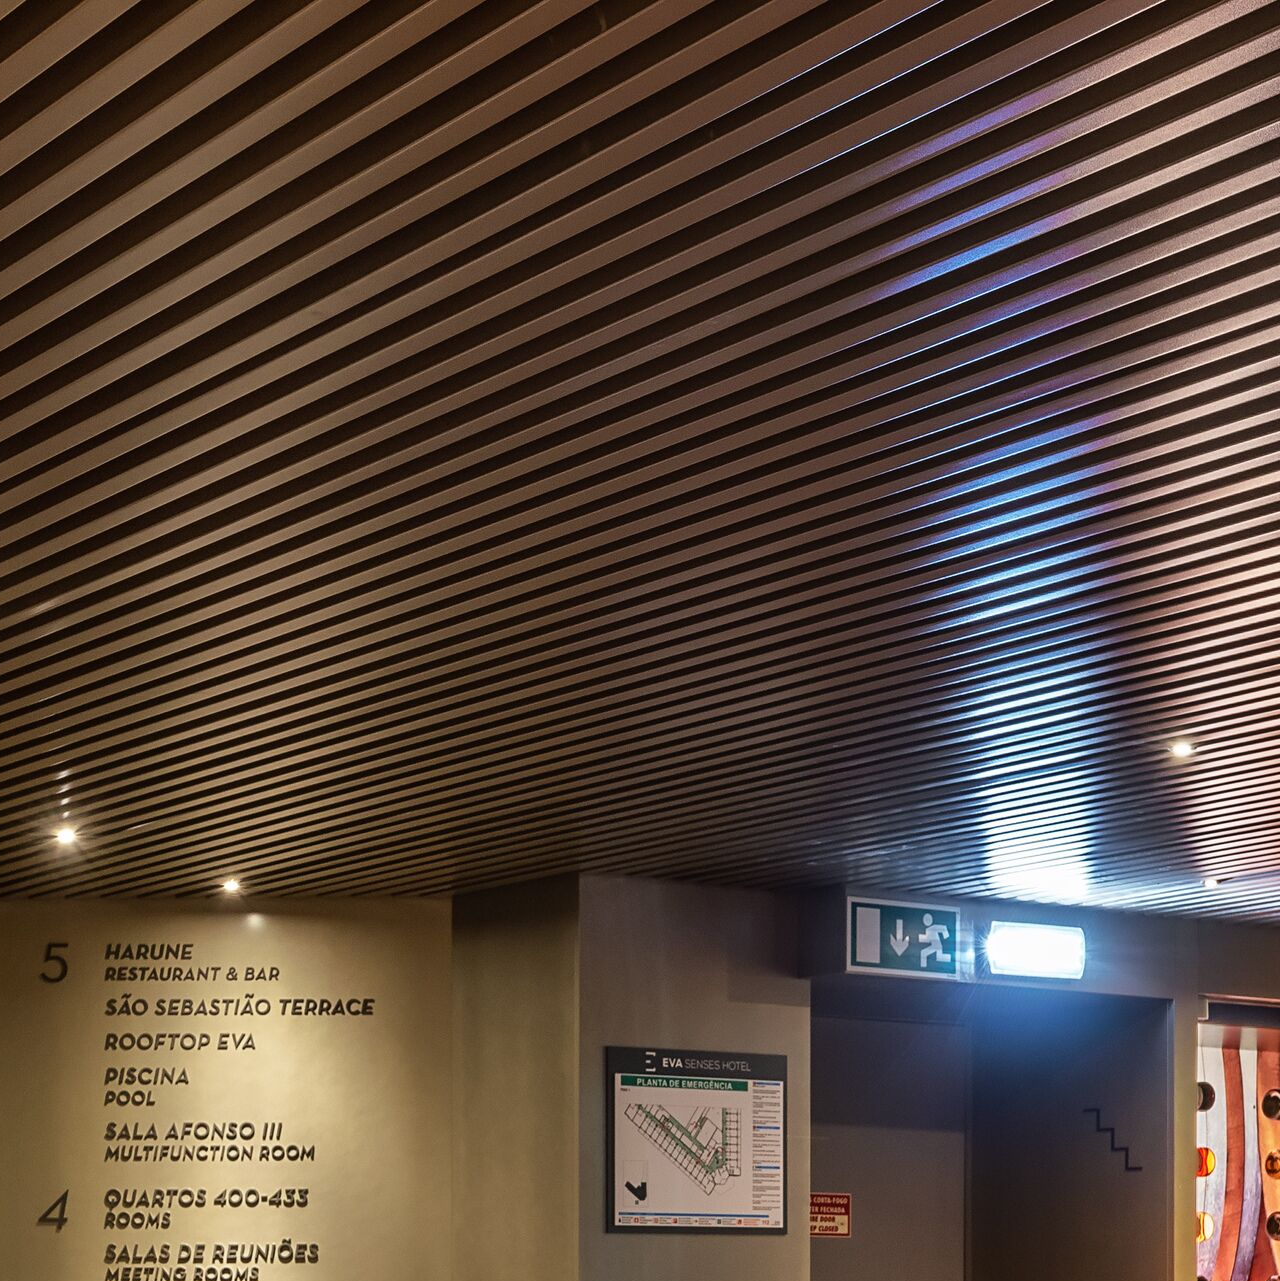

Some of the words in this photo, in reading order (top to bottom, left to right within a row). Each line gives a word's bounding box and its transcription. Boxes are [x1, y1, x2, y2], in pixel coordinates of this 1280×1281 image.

[103, 942, 194, 961] HARUNE
[38, 942, 69, 984] 5
[103, 966, 221, 982] RESTAURANT
[225, 966, 239, 982] &
[244, 966, 280, 981] BAR
[103, 994, 149, 1017] SÃO
[154, 994, 271, 1017] SEBASTIÃO
[278, 998, 376, 1016] TERRACE
[103, 1033, 210, 1051] ROOFTOP
[217, 1033, 256, 1051] EVA
[662, 1057, 683, 1069] EVA
[684, 1058, 721, 1071] SENSES
[721, 1059, 752, 1072] HOTEL
[103, 1067, 190, 1086] PISCINA
[636, 1077, 667, 1088] PLANTA
[668, 1078, 680, 1088] DE
[681, 1078, 734, 1091] EMERGÊNCIA
[103, 1090, 156, 1107] POOL
[103, 1122, 158, 1141] SALA
[165, 1122, 256, 1141] AFONSO
[262, 1122, 284, 1141] III
[103, 1145, 254, 1162] MULTIFUNCTION
[259, 1145, 316, 1162] ROOM
[103, 1189, 207, 1210] QUARTOS
[213, 1188, 310, 1208] 400-433
[36, 1188, 69, 1232] 4
[103, 1212, 171, 1229] ROOMS
[103, 1243, 171, 1263] SALAS
[177, 1243, 206, 1263] DE
[211, 1238, 320, 1264] REUNIÕES
